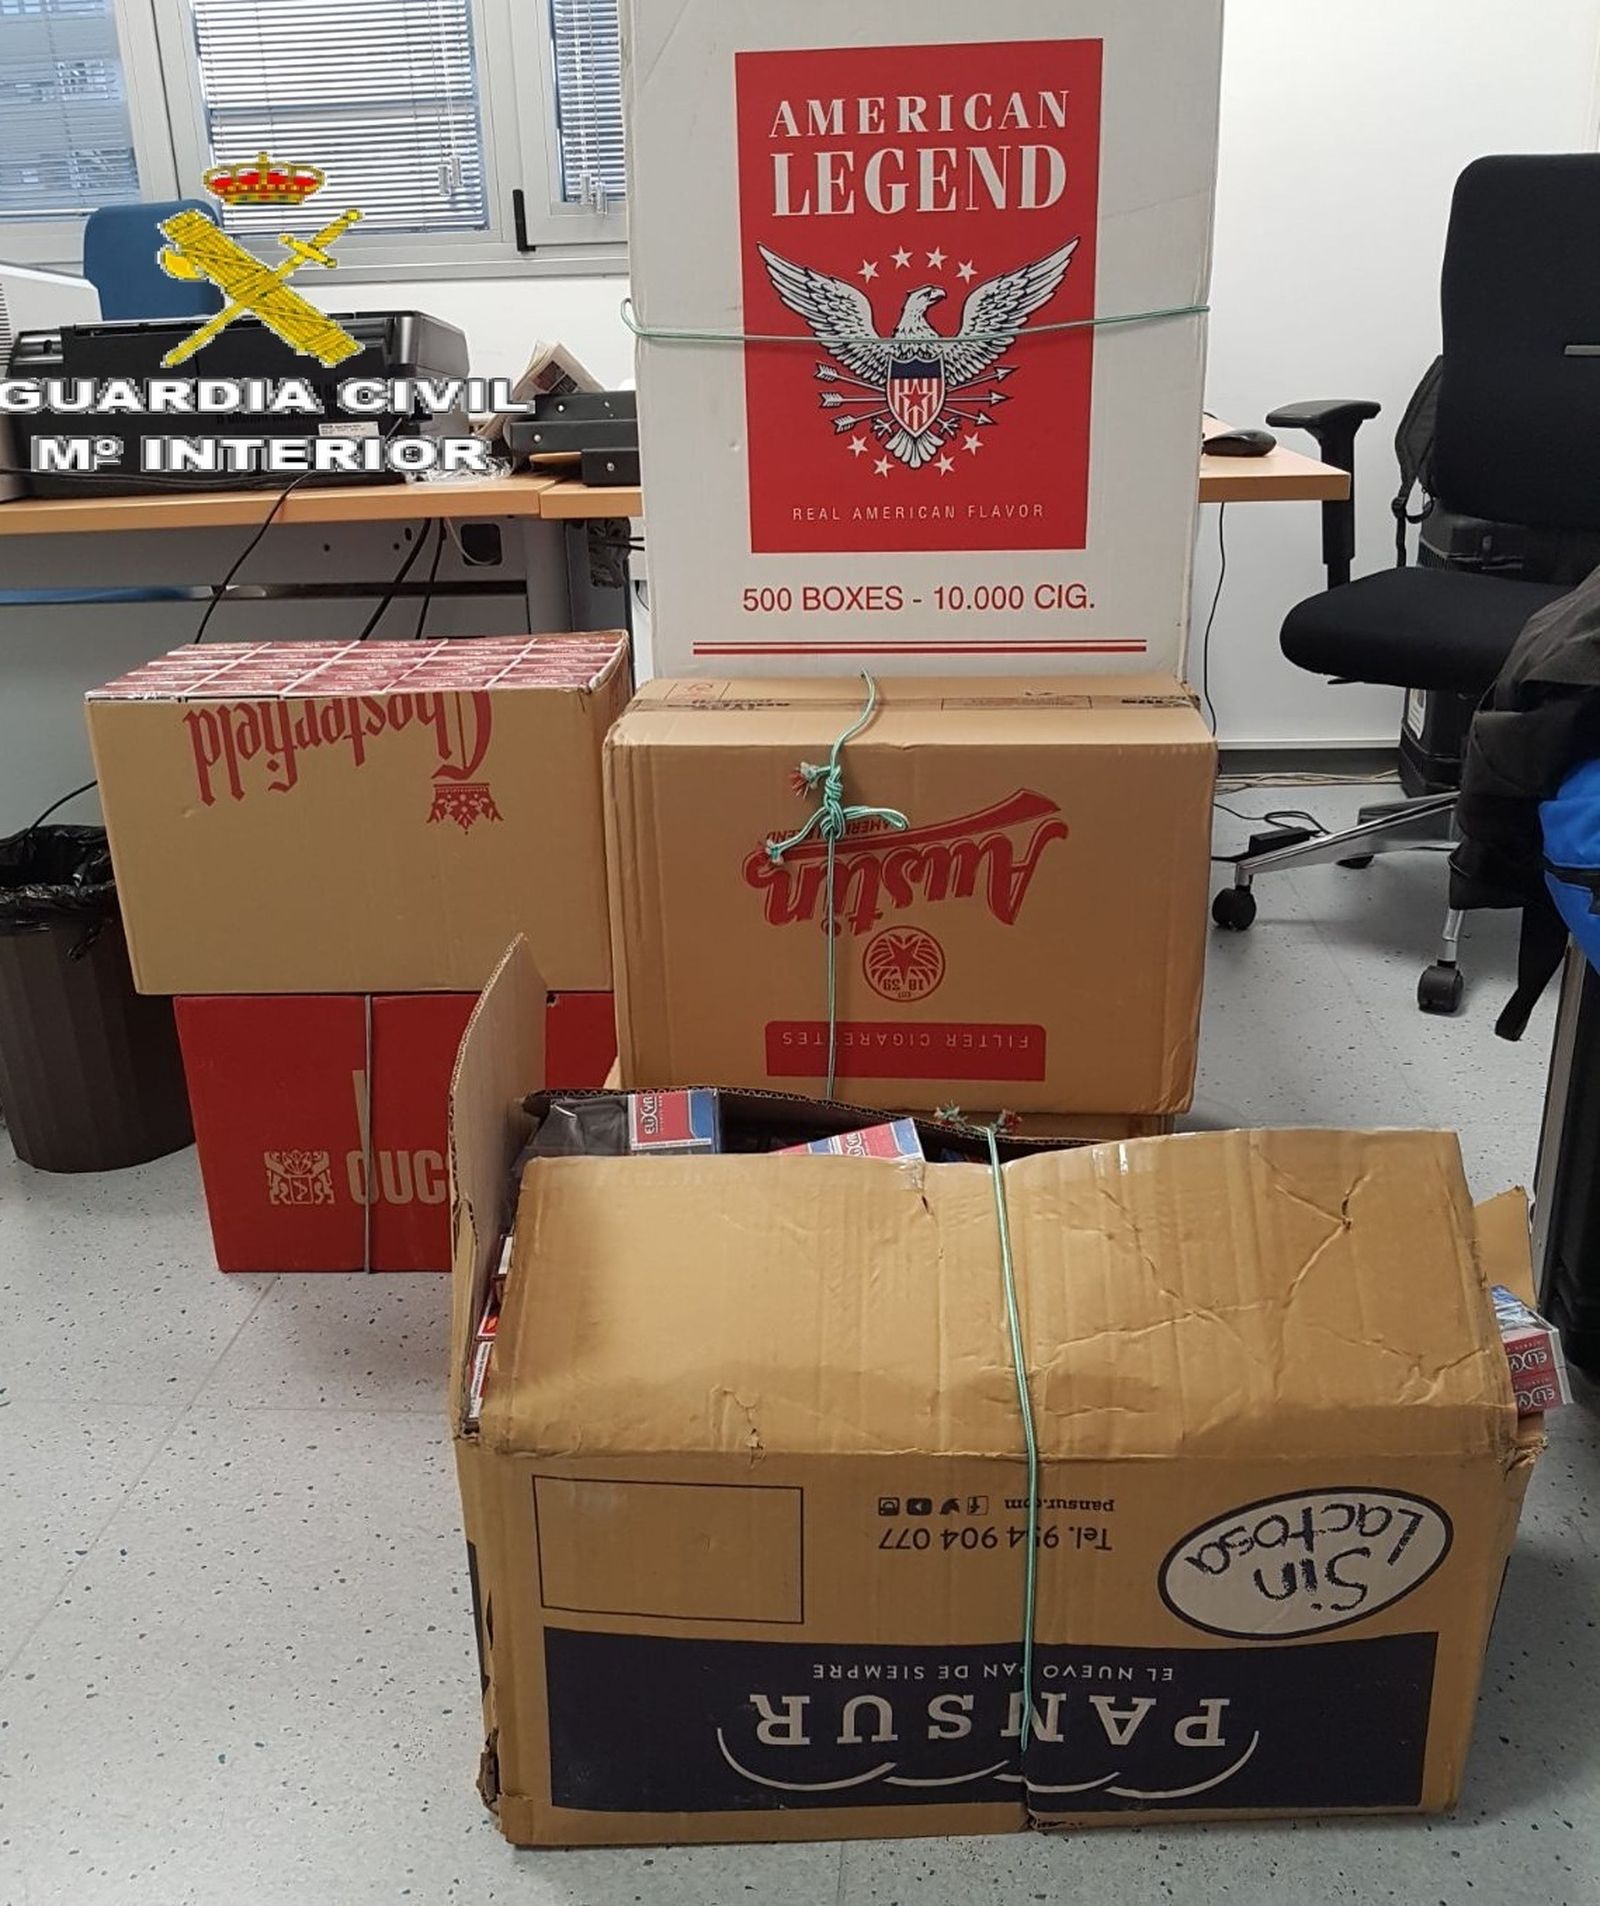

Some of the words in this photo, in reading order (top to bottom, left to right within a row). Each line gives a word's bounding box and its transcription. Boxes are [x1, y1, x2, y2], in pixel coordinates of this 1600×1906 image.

[768, 90, 1070, 138] AMERICAN
[770, 144, 1067, 217] LEGEND
[792, 506, 841, 521] REAL
[853, 504, 956, 520] AMERICAN
[968, 503, 1044, 519] FLAVOR
[743, 587, 792, 611] 500
[801, 585, 904, 611] BOXES
[933, 584, 1024, 610] 10.000
[1033, 582, 1095, 610] CIG.
[182, 688, 493, 807] Chesterfield
[742, 818, 1069, 938] Austin
[782, 1031, 930, 1047] CIGARETES
[946, 1032, 1028, 1049] FILTER
[878, 1526, 931, 1550] 077
[940, 1526, 999, 1550] 904
[1067, 1525, 1113, 1551] Tel.
[1184, 1502, 1425, 1575] Lactosa
[1253, 1546, 1371, 1611] Sin
[813, 1663, 926, 1681] SIEMPRE
[937, 1663, 969, 1680] DE
[984, 1662, 1025, 1680] AN
[1043, 1663, 1133, 1682] NUEVO
[1147, 1668, 1175, 1682] EL
[749, 1690, 1231, 1748] PANSUR
